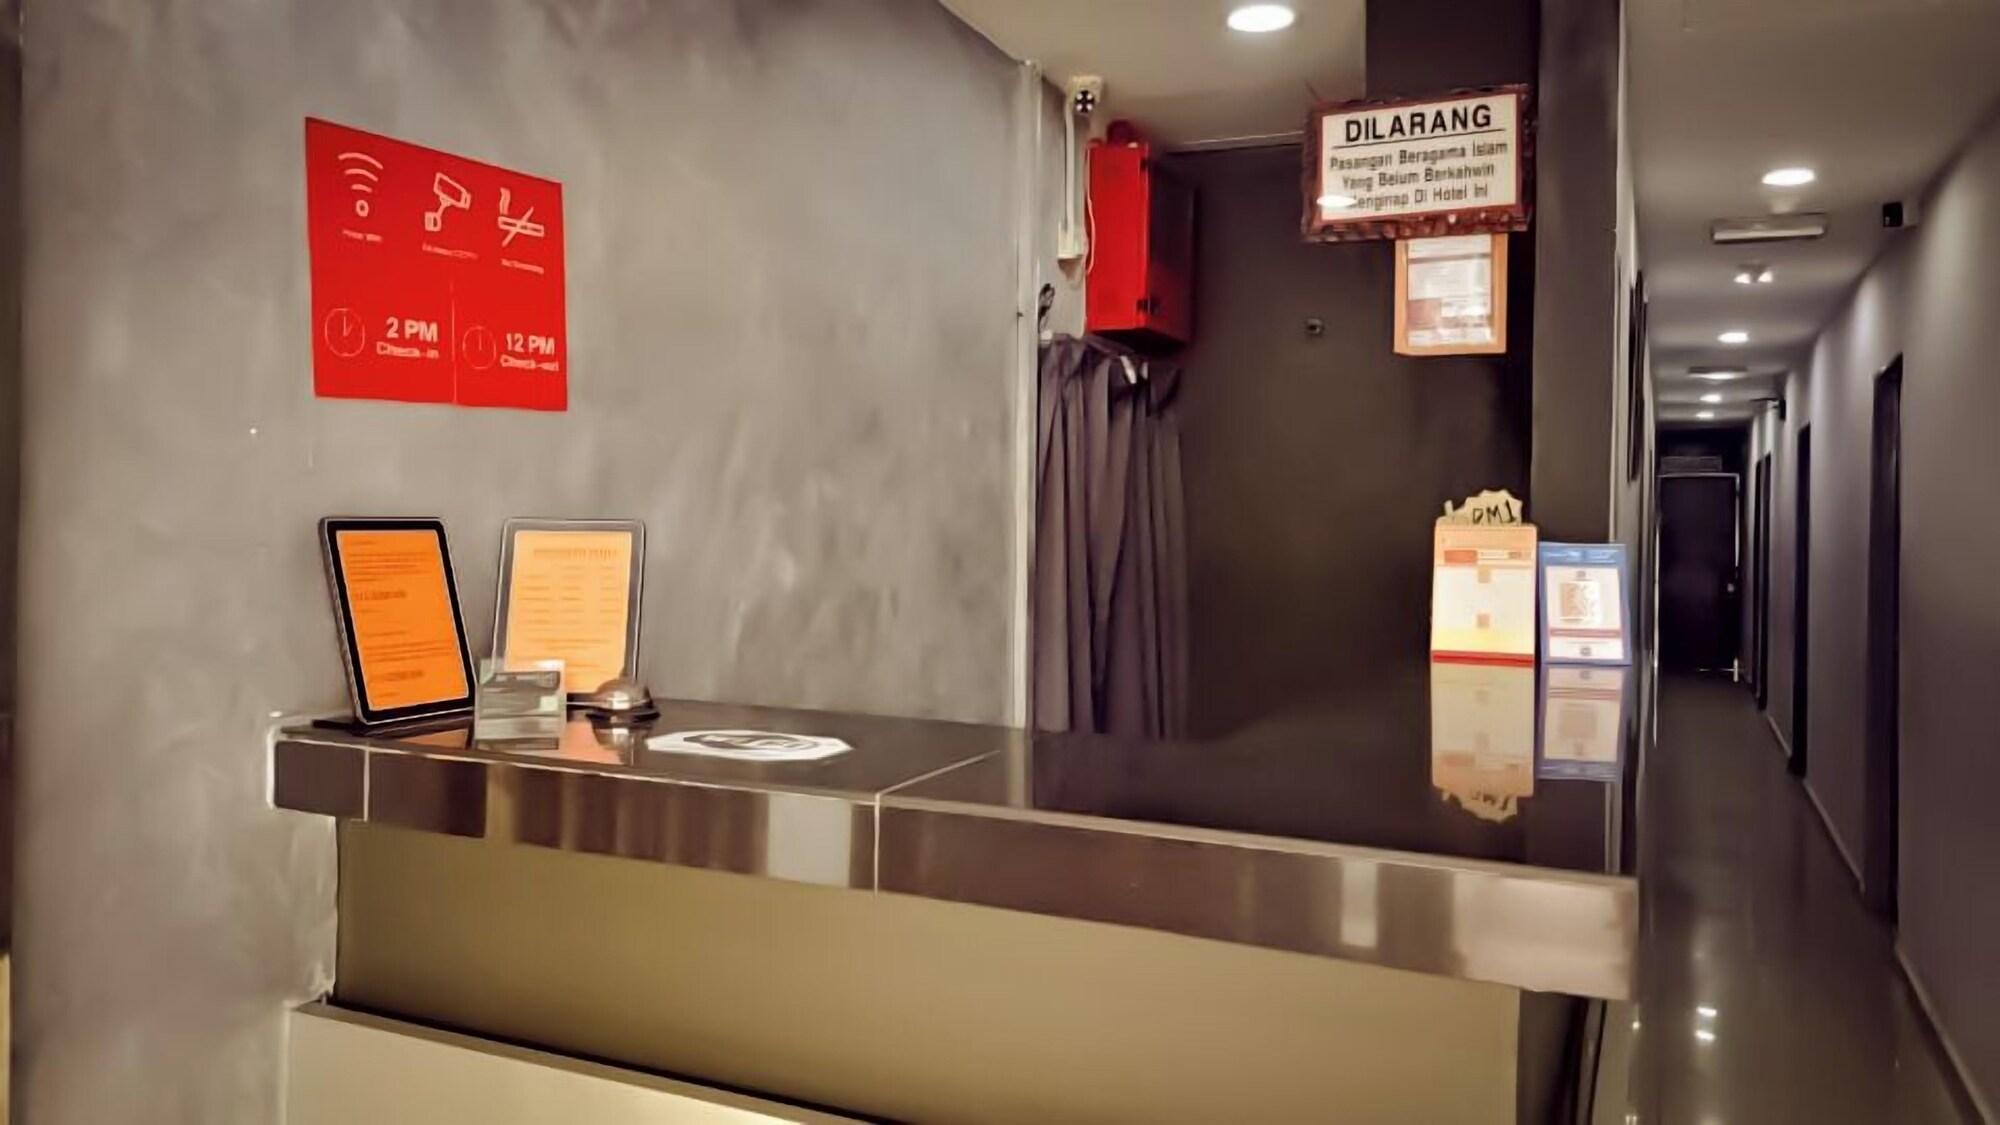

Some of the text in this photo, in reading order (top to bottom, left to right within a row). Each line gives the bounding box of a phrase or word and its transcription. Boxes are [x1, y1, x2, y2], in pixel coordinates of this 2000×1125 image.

[1345, 104, 1491, 142] DILARANG
[1330, 141, 1508, 171] Pasangan Beragama Islam
[1342, 176, 1374, 192] Yang
[386, 316, 438, 342] 2 PM
[506, 333, 555, 355] 12 PM
